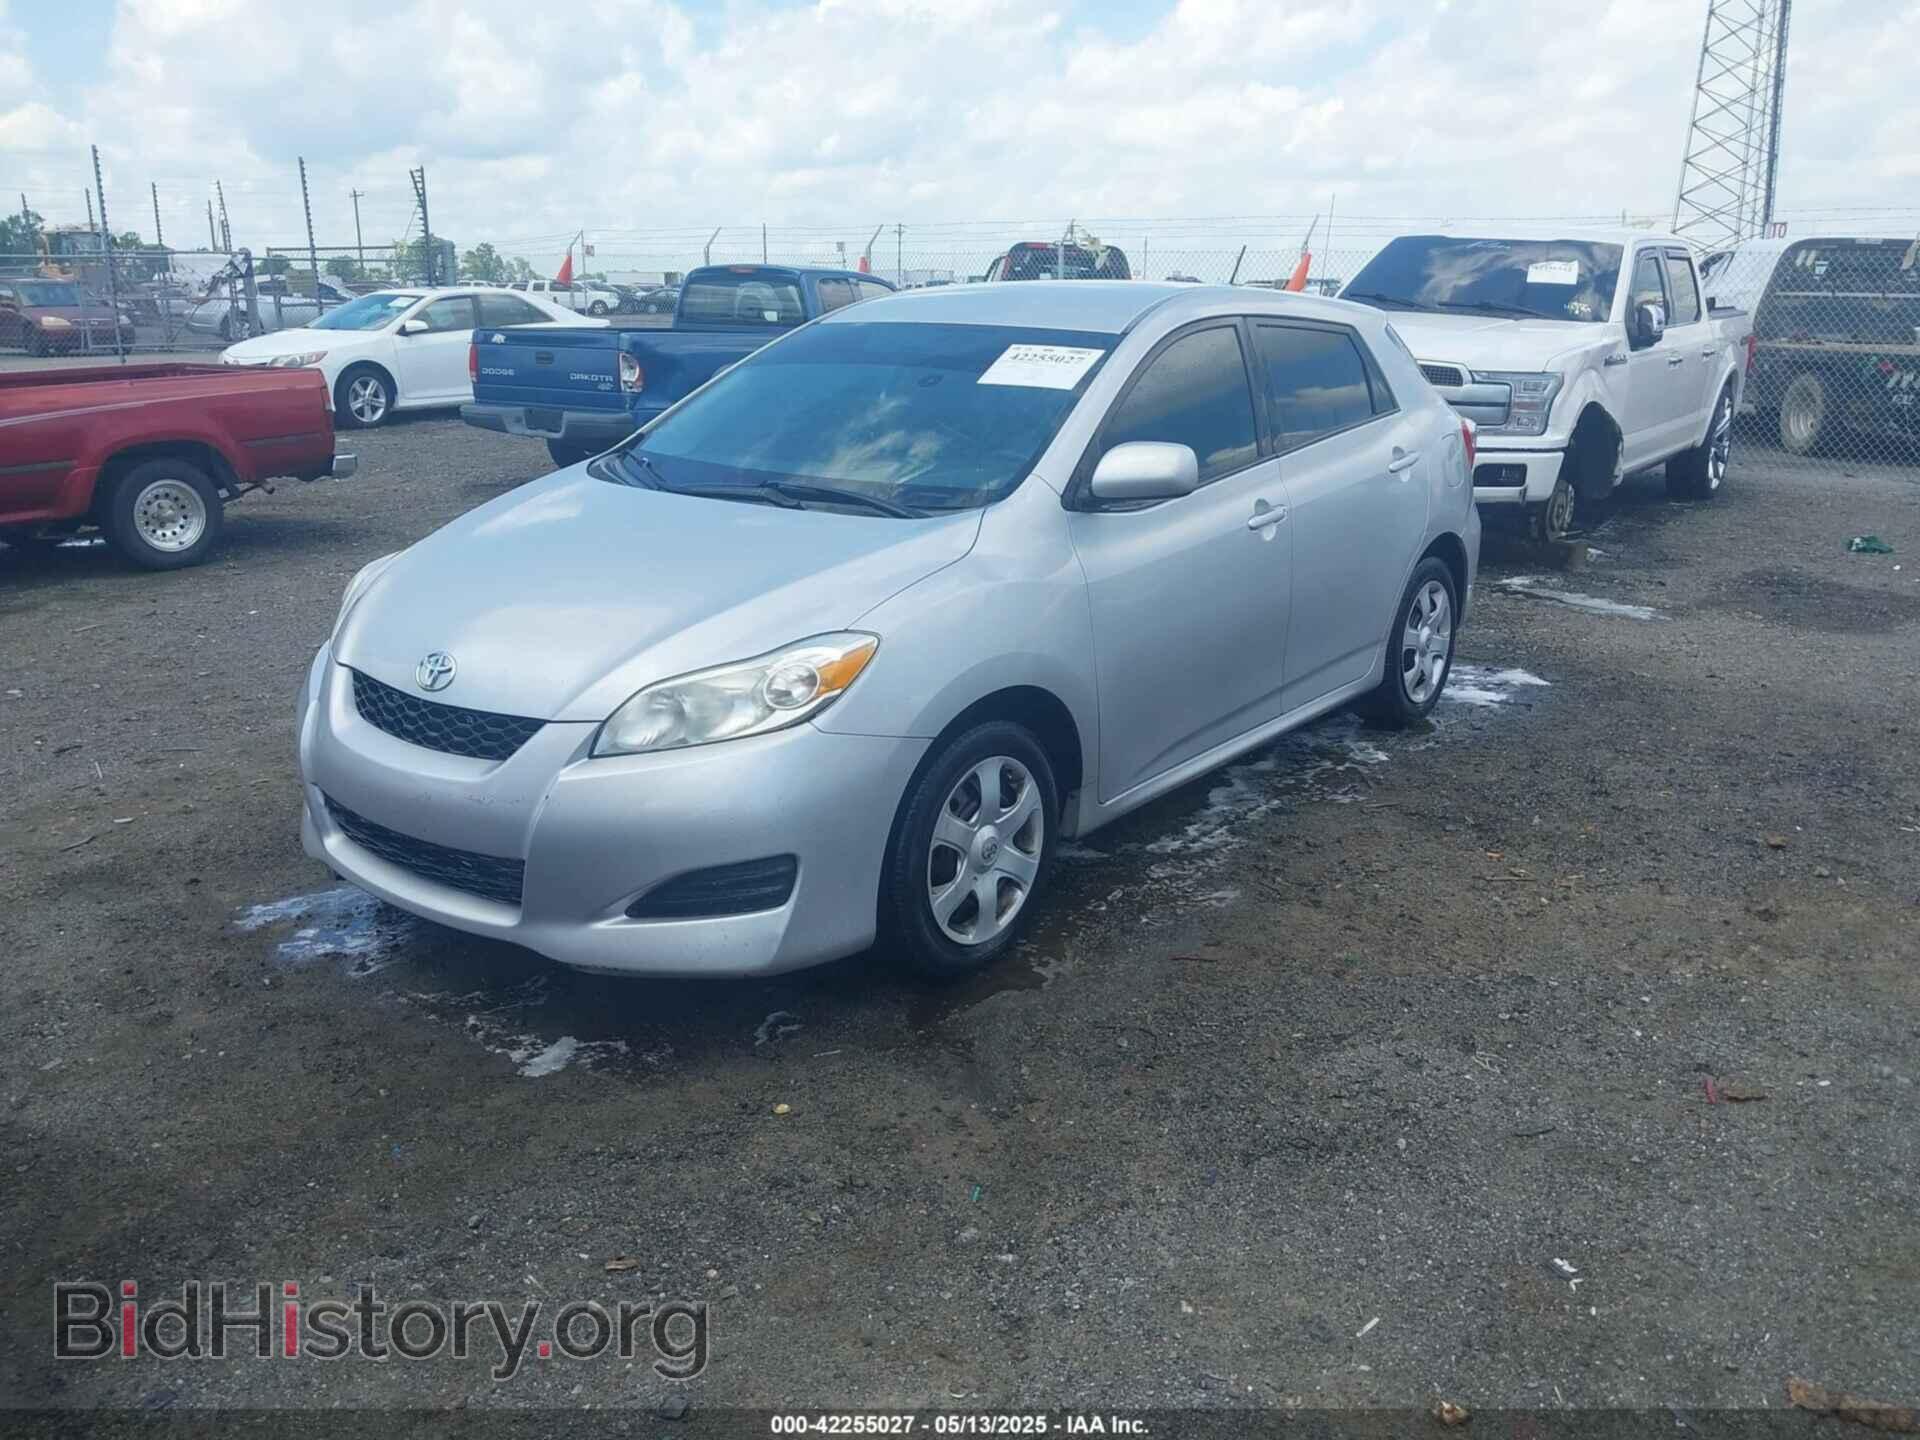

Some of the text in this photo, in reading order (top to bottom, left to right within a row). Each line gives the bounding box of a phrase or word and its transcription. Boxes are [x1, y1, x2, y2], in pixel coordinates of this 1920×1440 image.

[1010, 353, 1085, 364] 42255027
[481, 367, 515, 376] DODGE
[569, 373, 613, 382] DAKOTA
